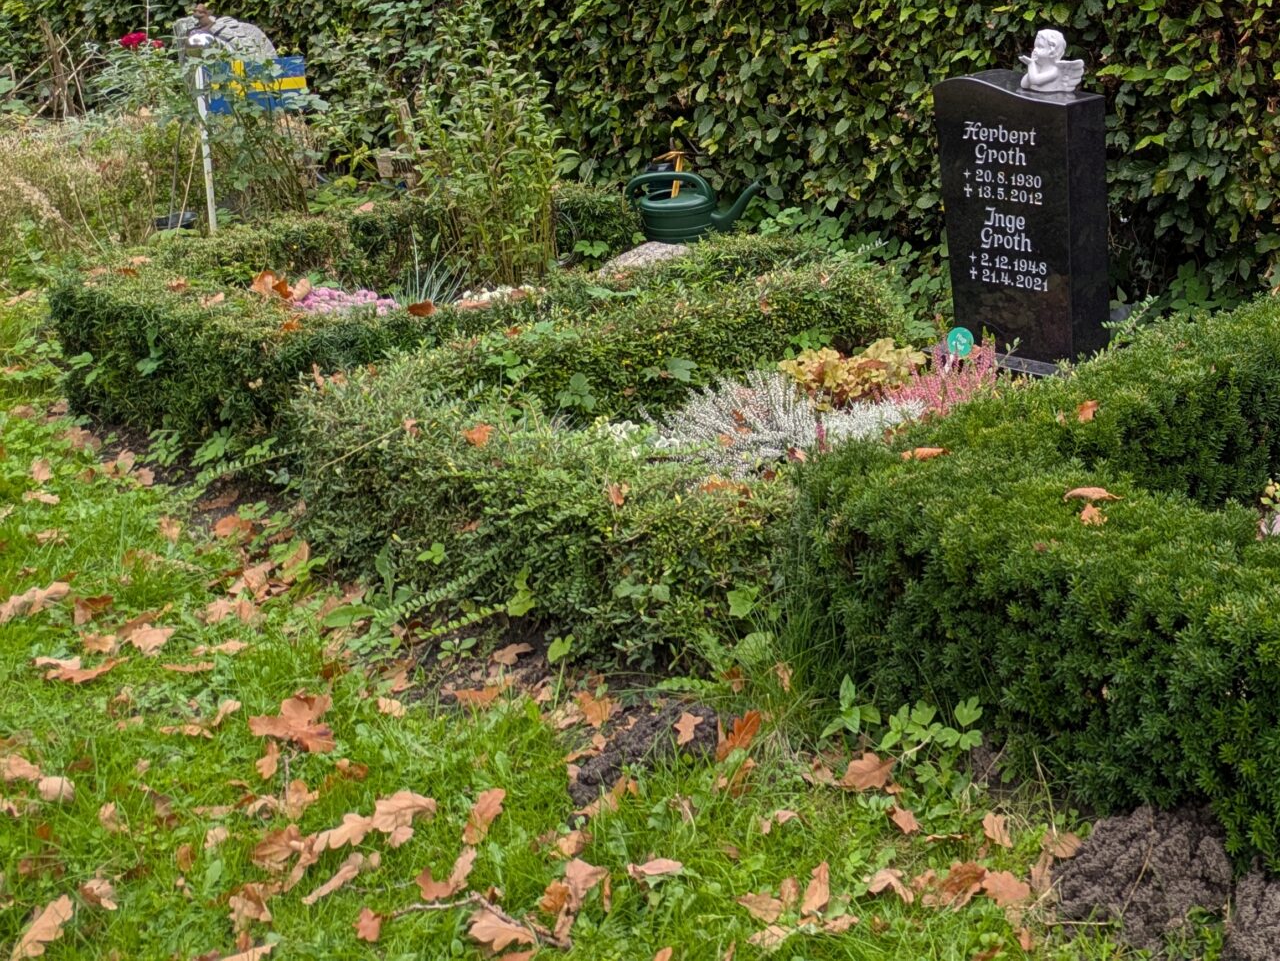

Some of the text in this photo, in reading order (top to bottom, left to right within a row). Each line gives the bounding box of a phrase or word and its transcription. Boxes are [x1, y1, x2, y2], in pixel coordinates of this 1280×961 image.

[962, 120, 1037, 146] Herbert
[974, 143, 1027, 166] Groth
[984, 206, 1026, 233] Inge
[980, 228, 1033, 253] Groth
